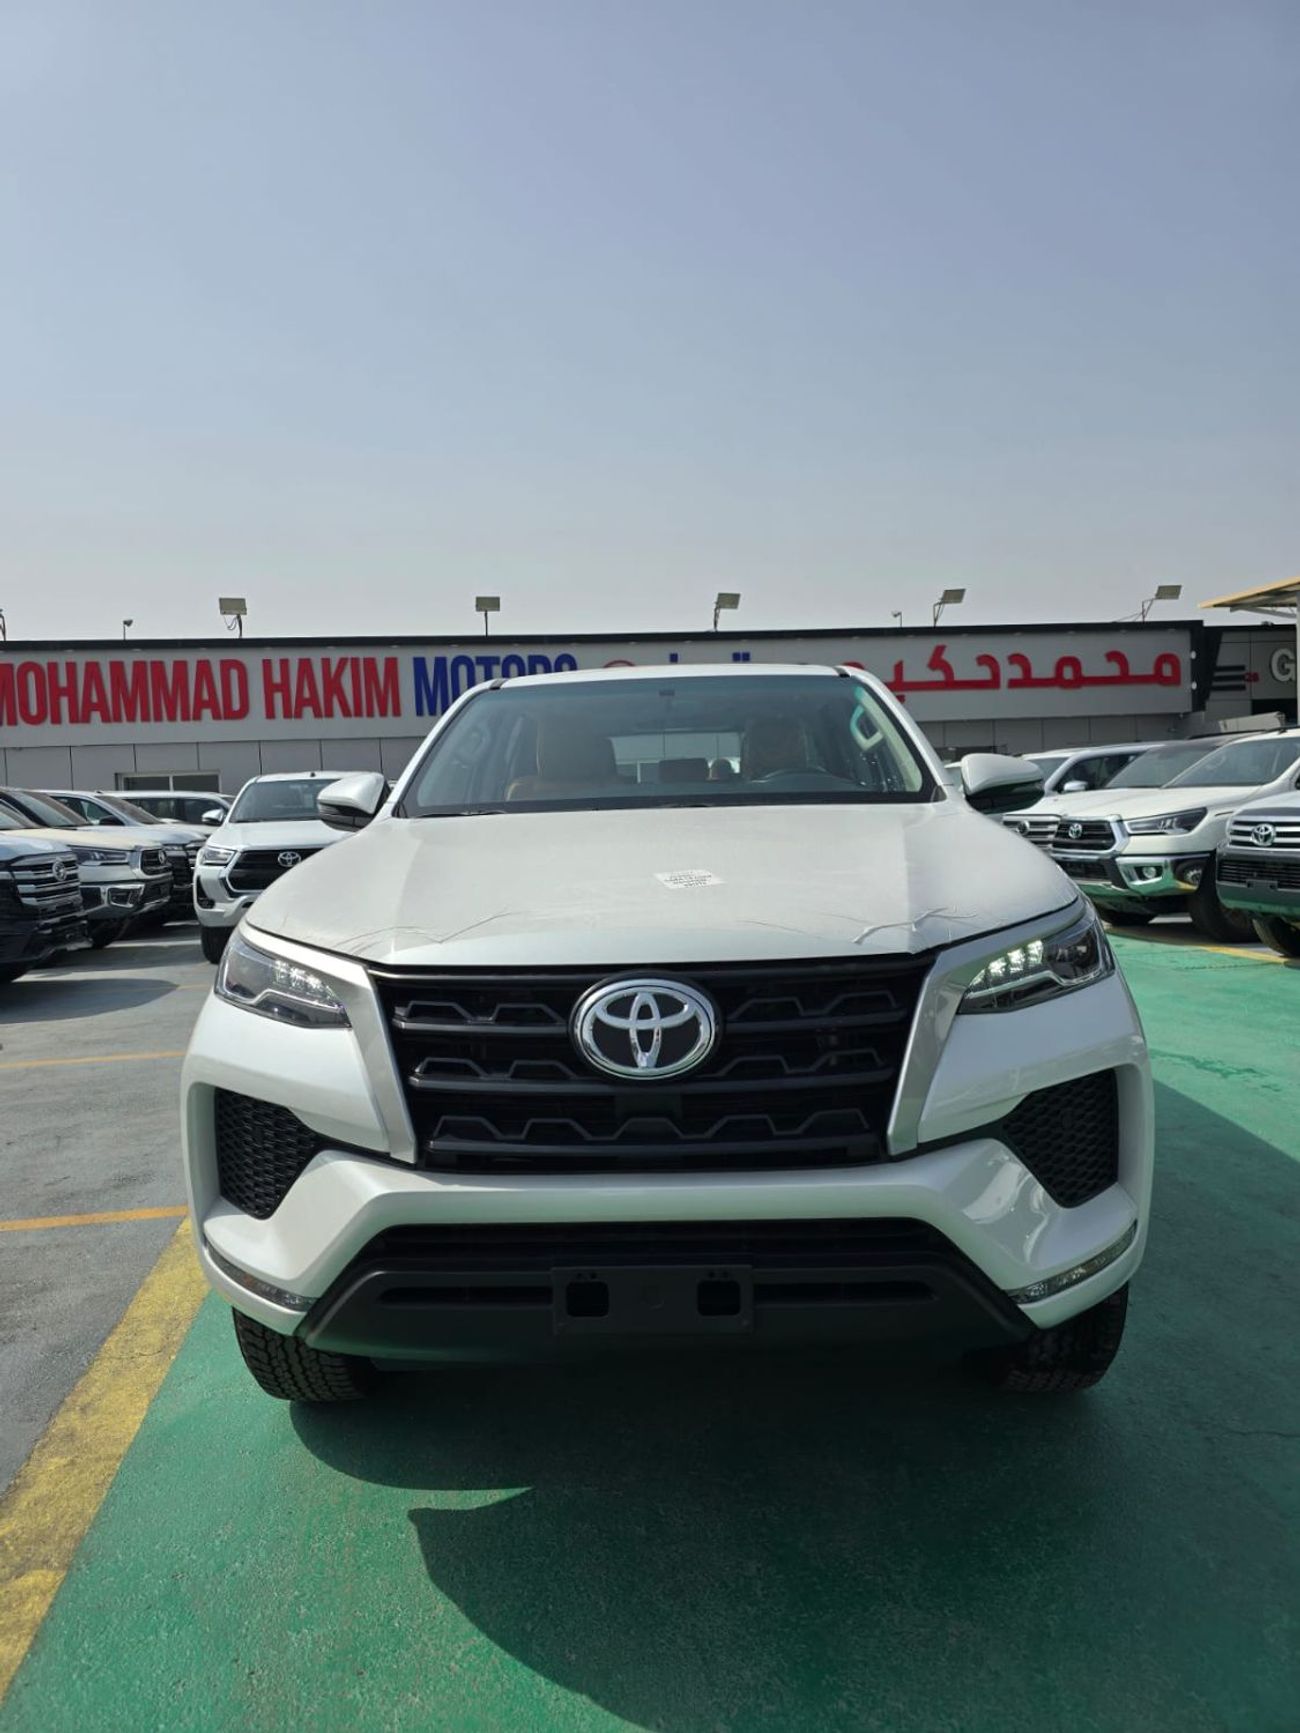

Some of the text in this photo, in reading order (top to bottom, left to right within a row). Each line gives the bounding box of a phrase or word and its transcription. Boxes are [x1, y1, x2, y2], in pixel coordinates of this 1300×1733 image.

[262, 657, 401, 719] HAKIM
[843, 644, 1181, 704] محمد حكي
